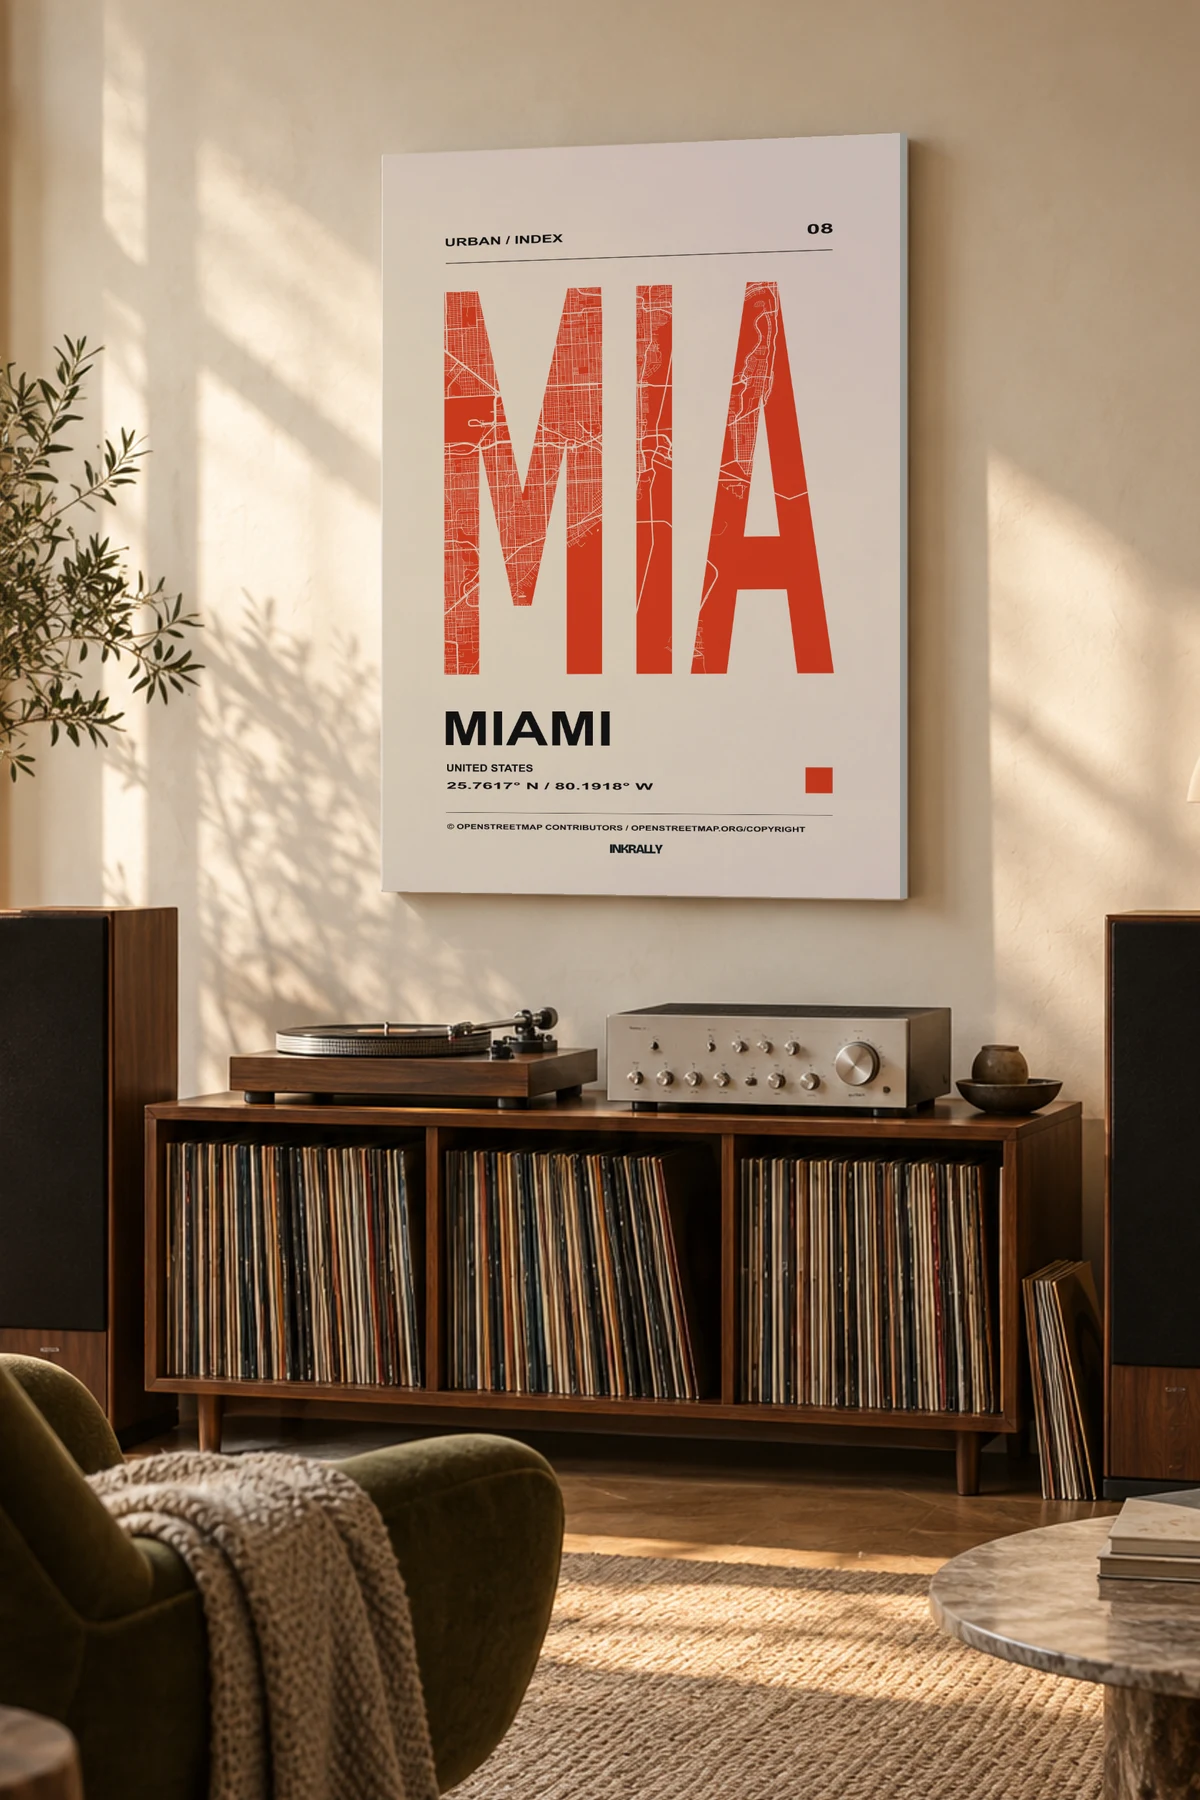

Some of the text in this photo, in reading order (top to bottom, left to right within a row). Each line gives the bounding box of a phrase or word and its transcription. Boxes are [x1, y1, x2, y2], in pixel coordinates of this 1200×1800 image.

[806, 222, 834, 235] 08
[445, 233, 563, 247] URBAN / INDEX
[444, 281, 834, 675] MIA
[445, 711, 611, 746] MIAMI
[446, 763, 534, 773] UNITED STATES
[446, 781, 654, 791] 25.7617° N / 80.1918° W
[456, 823, 543, 831] OPENSTREETMAP
[544, 823, 624, 832] CONTRIBUTORS
[630, 824, 806, 834] OPENSTREETMAP.ORG/COPYRIGHT
[609, 843, 664, 854] INKRALLY
